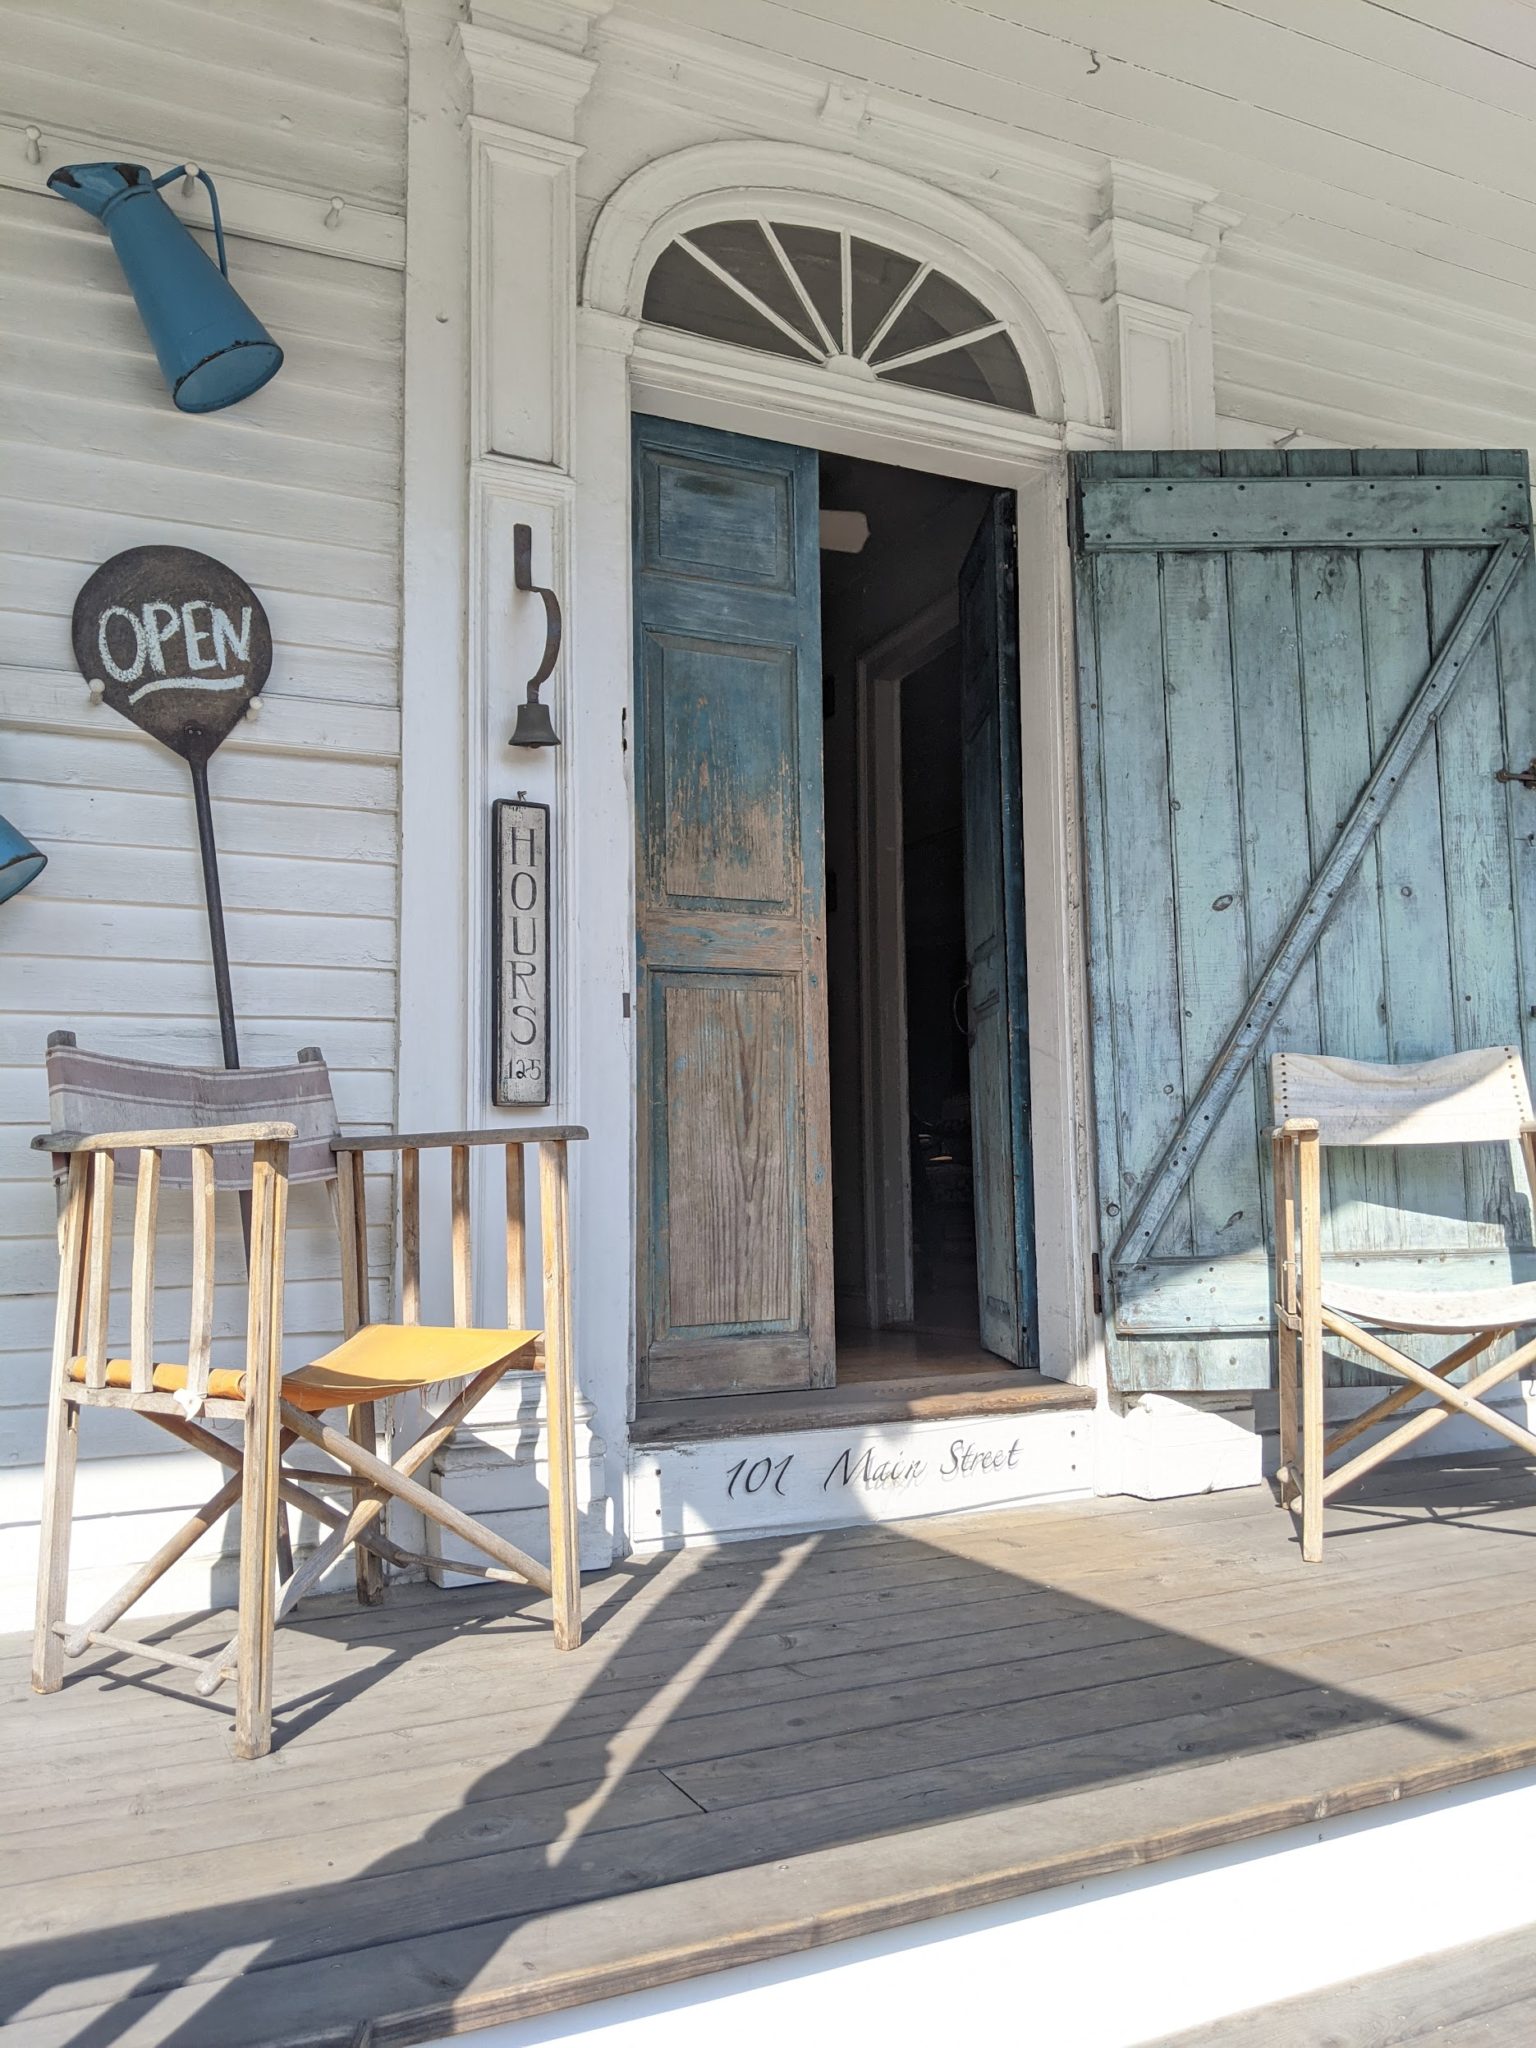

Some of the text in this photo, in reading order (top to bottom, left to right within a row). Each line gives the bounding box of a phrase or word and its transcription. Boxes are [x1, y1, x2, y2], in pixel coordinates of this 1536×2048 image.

[98, 600, 252, 682] OPEN
[506, 826, 539, 1046] HOURS
[726, 1438, 1023, 1500] 101 Main Street
